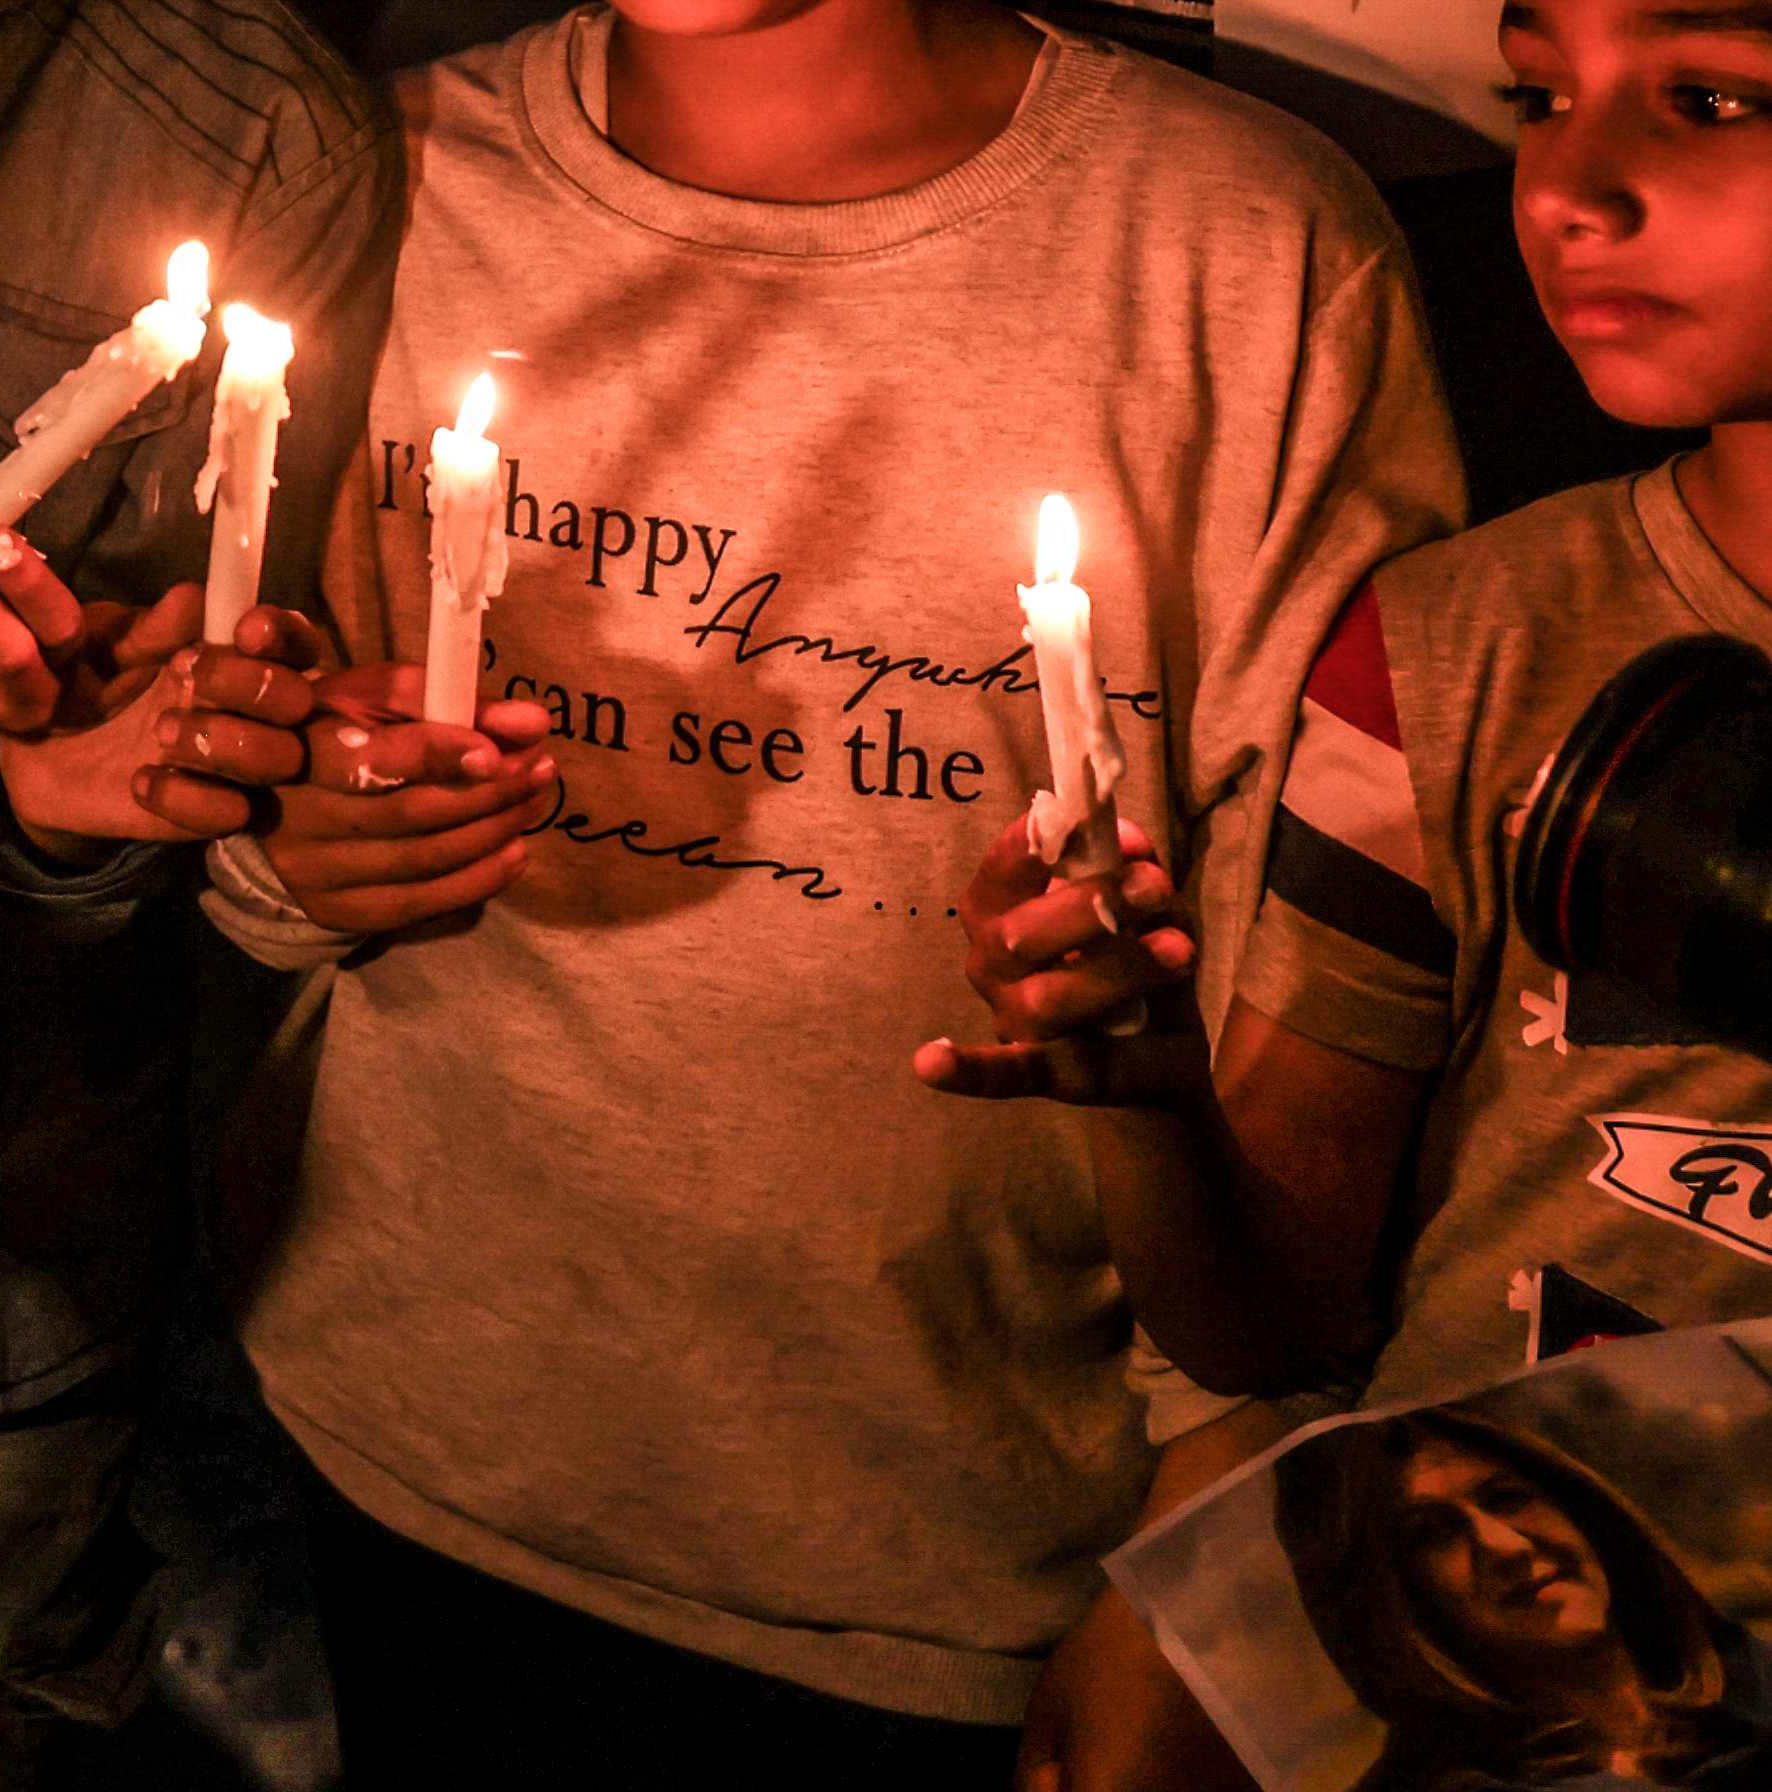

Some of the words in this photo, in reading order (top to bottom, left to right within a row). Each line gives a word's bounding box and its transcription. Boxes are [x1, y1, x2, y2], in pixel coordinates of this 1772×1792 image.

[505, 459, 737, 605] happy
[669, 711, 805, 783] see
[844, 708, 985, 803] the
